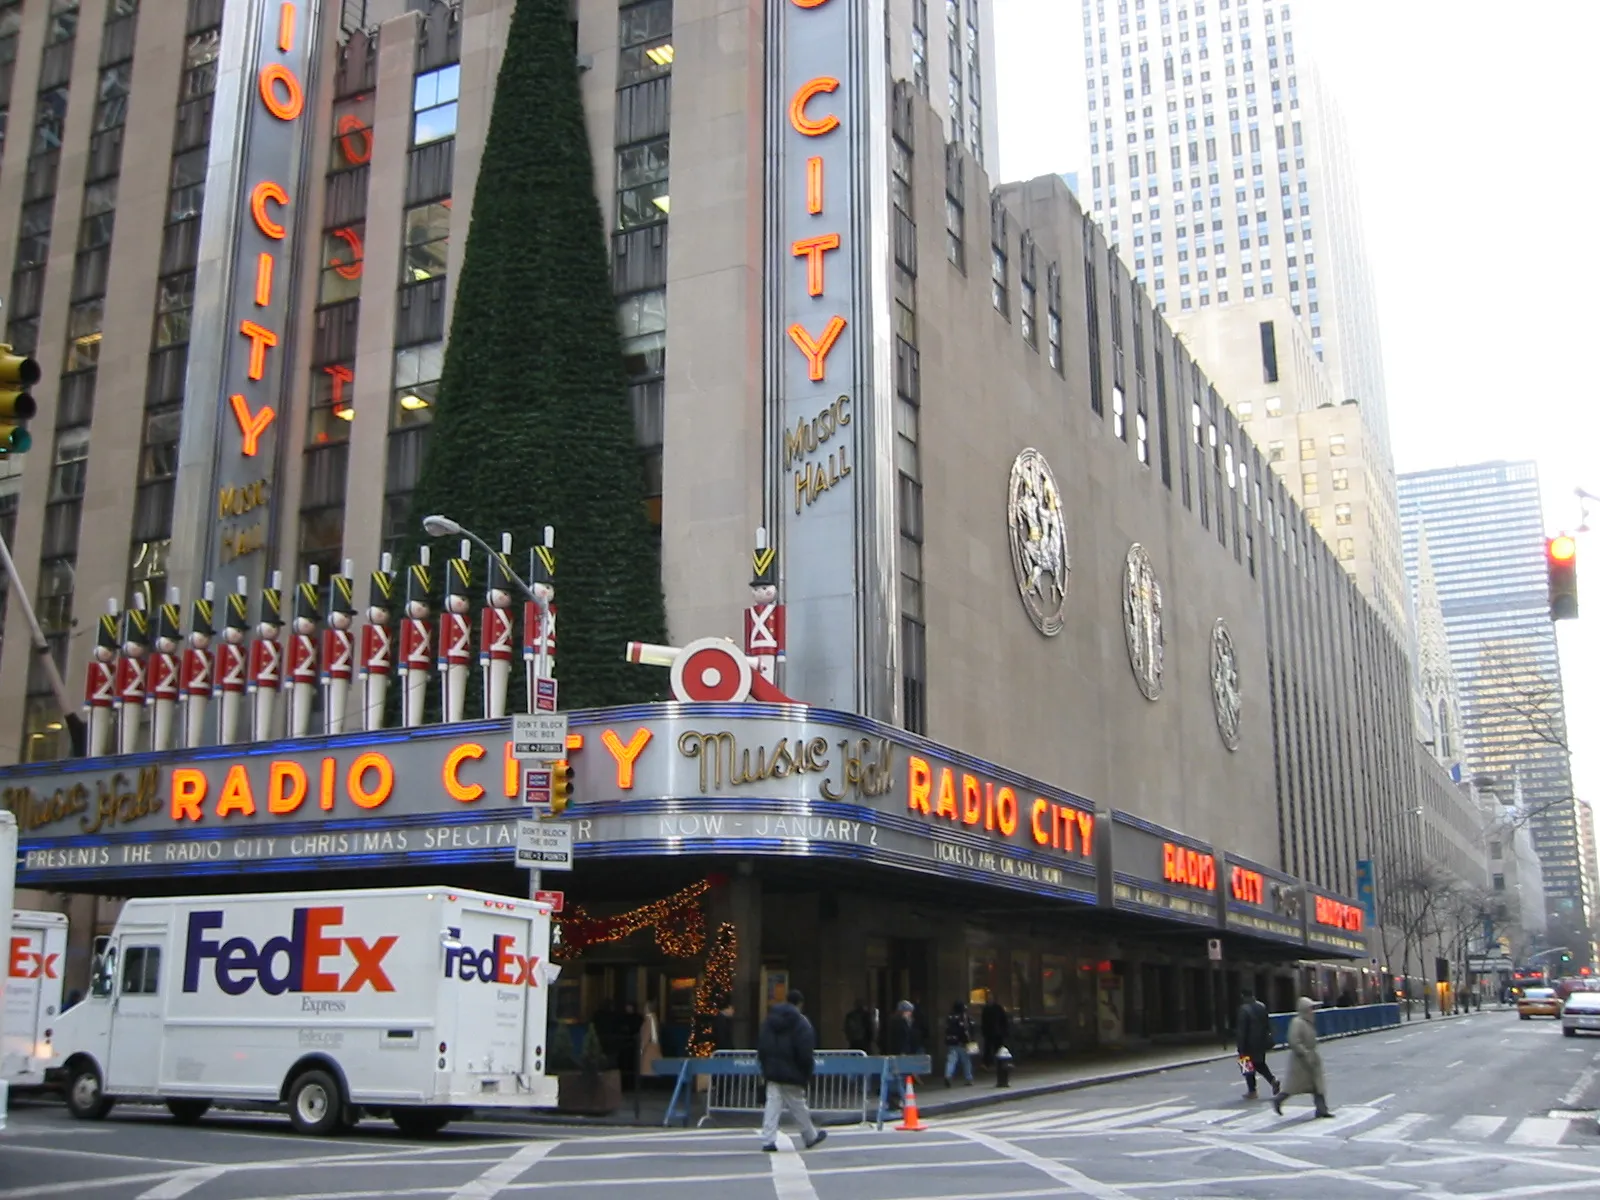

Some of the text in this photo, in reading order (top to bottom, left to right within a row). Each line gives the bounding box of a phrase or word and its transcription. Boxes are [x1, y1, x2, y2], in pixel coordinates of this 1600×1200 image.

[787, 76, 847, 382] CITY
[229, 181, 290, 457] CITY
[784, 394, 851, 471] MUSIC
[794, 446, 851, 514] HALL
[516, 721, 564, 729] DON'T BLOCK
[524, 730, 556, 738] THE BOX
[170, 750, 394, 822] RADIO
[678, 729, 895, 801] Music Hall
[521, 827, 568, 837] DON'T BLOCK
[660, 815, 724, 835] NOW
[756, 815, 861, 843] JANUARY
[869, 826, 878, 846] 2
[908, 755, 1094, 857] RADIO CITY
[26, 846, 109, 868] PRESENTS
[123, 844, 152, 863] THE
[165, 840, 221, 861] RADIO
[234, 838, 276, 857] CITY
[291, 830, 408, 856] CHRISTMAS
[529, 837, 558, 847] THE BOX
[933, 841, 974, 867] TICKETS
[978, 852, 996, 871] ARE
[1162, 842, 1217, 891] RADIO
[1231, 865, 1264, 905] CITY
[182, 906, 399, 996] FedEx
[445, 926, 540, 988] FedEx
[301, 995, 347, 1016] Express
